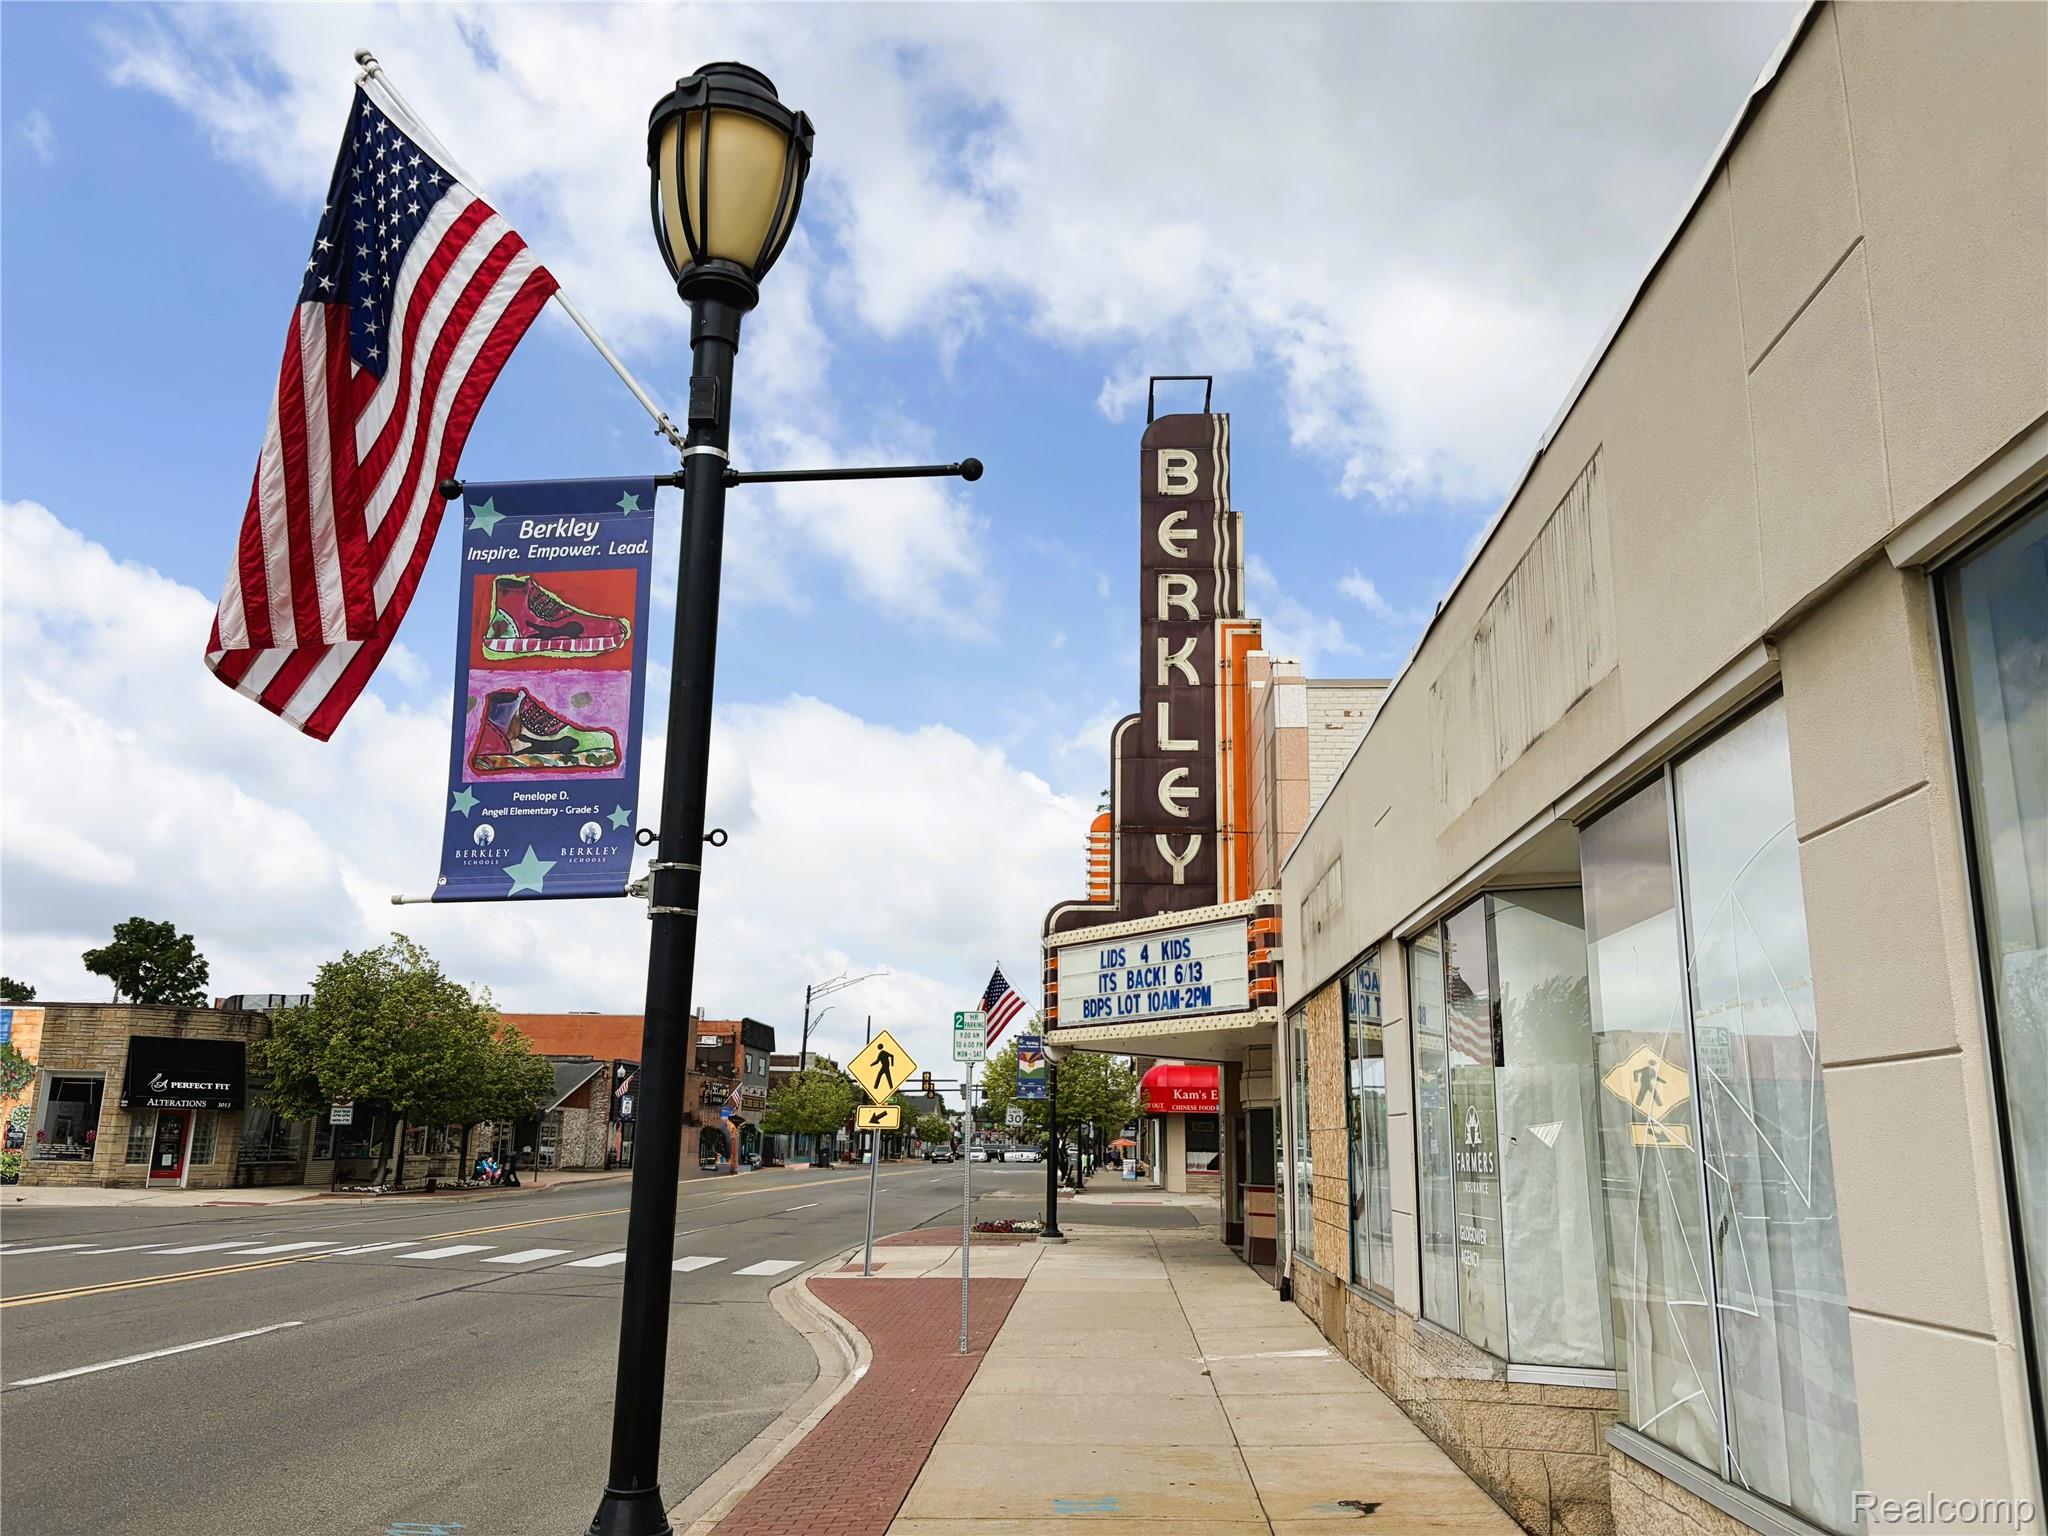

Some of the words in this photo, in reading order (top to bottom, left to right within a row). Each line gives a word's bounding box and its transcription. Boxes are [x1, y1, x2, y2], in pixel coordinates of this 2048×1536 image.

[519, 518, 600, 541] Berkley
[467, 546, 521, 563] Inspire.
[527, 544, 601, 561] Empower.
[608, 540, 650, 555] Lead.
[1155, 448, 1202, 885] BERKLEY
[513, 791, 558, 802] Penelope
[560, 790, 570, 801] D.
[481, 807, 509, 818] Angell
[509, 807, 559, 817] Elementary
[565, 806, 592, 815] Grade
[593, 805, 599, 814] 5
[455, 849, 510, 859] BERKLEY
[560, 847, 618, 857] BERKLEY
[1100, 948, 1126, 969] LIDS
[1140, 944, 1149, 963] 4
[1161, 937, 1191, 961] KIDS
[1098, 972, 1117, 993] ITS
[1126, 966, 1167, 990] BACK!
[1174, 961, 1203, 984] 6/13
[1083, 997, 1112, 1019] BDPS
[1117, 994, 1141, 1015] LOT
[1147, 985, 1212, 1012] 10AM-2PM
[955, 1014, 963, 1028] 2
[170, 1081, 213, 1090] PERFECT
[1173, 1088, 1207, 1100] Kam's
[147, 1098, 207, 1108] ALTERATIONS
[1008, 1114, 1022, 1123] 30
[1456, 1152, 1494, 1173] FARMERS
[1462, 1181, 1489, 1194] INSURANCE
[1461, 1248, 1480, 1268] AGENCY
